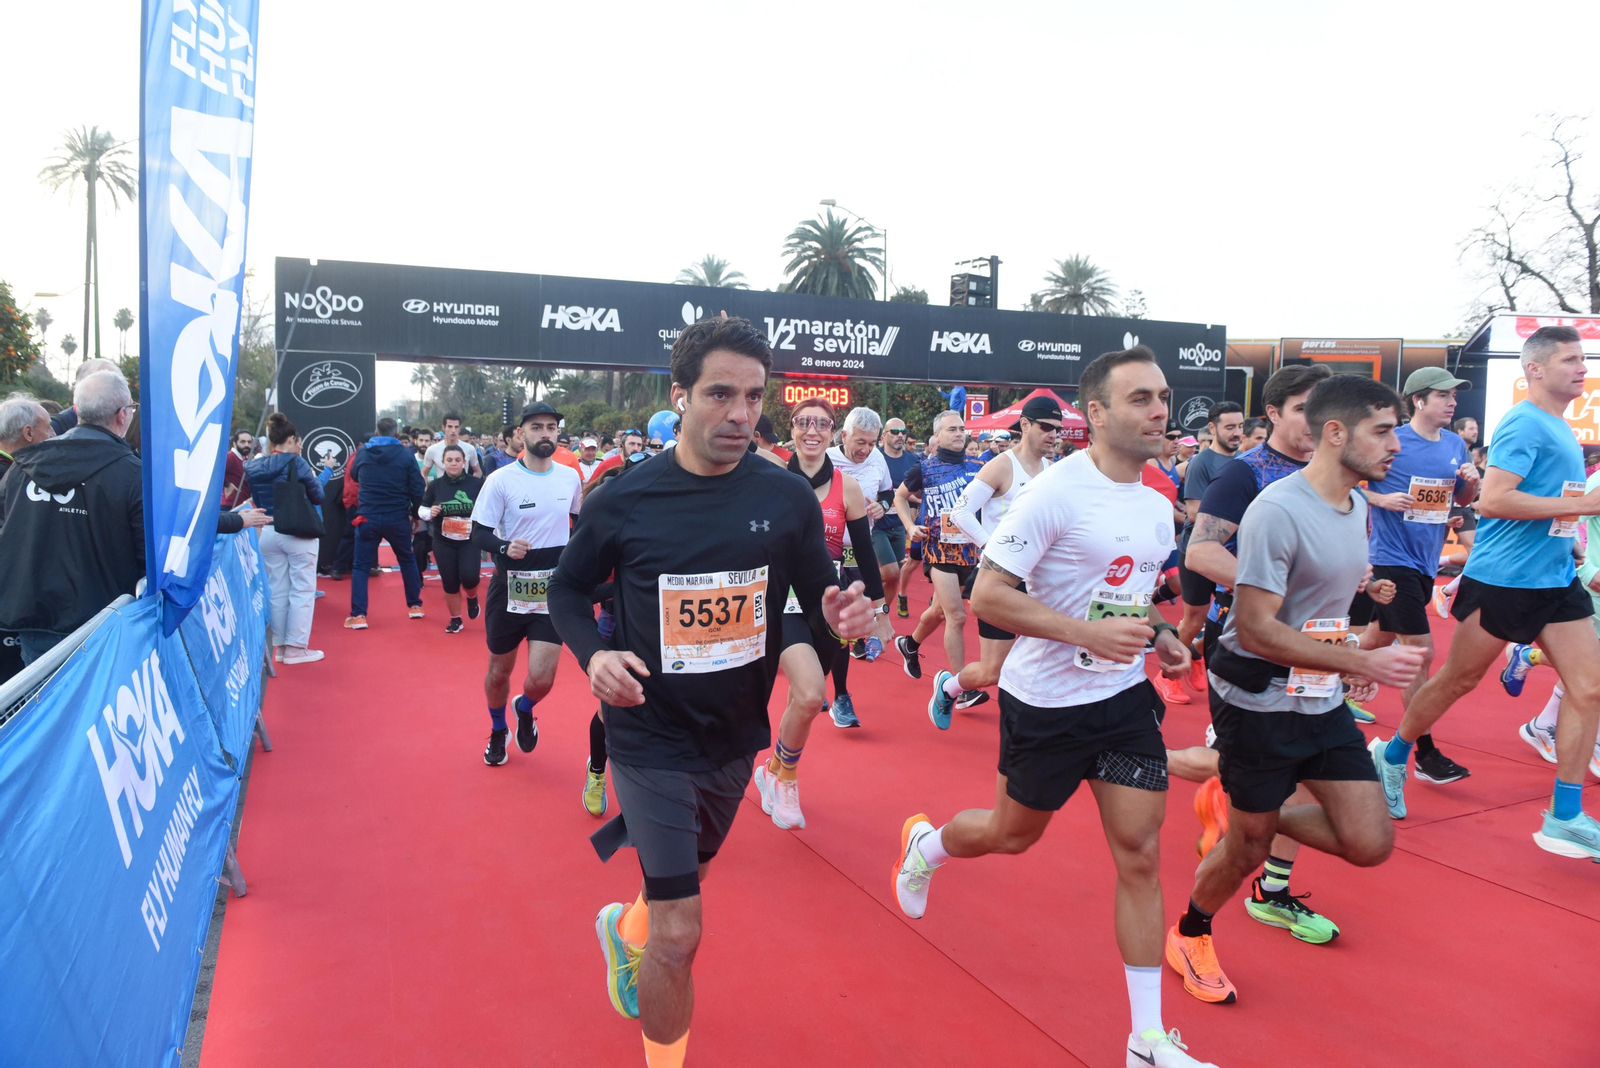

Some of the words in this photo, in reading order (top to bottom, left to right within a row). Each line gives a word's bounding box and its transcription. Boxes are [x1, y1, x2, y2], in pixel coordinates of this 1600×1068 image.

[433, 301, 500, 317] HYUNDAI
[285, 315, 331, 326] AYNTAMIENTO
[432, 315, 475, 325] Hyundauto
[476, 318, 500, 327] Motor
[541, 304, 621, 332] HOKA
[790, 318, 881, 340] maratón
[813, 335, 883, 356] sevilla
[930, 330, 992, 355] HOKA
[1037, 342, 1082, 354] HYUNDAI
[801, 356, 814, 367] 28
[814, 358, 842, 368] enero
[842, 359, 866, 370] 2024
[1416, 488, 1447, 503] 5636
[667, 575, 685, 586] MEDIO
[685, 574, 714, 586] MARATÓN
[728, 569, 757, 585] SEVILLA
[515, 581, 547, 595] 8183
[679, 595, 747, 627] 5537
[86, 648, 185, 870] HOKA
[141, 880, 169, 953] FLY
[155, 790, 195, 904] HUMAN
[182, 765, 204, 822] FLY
